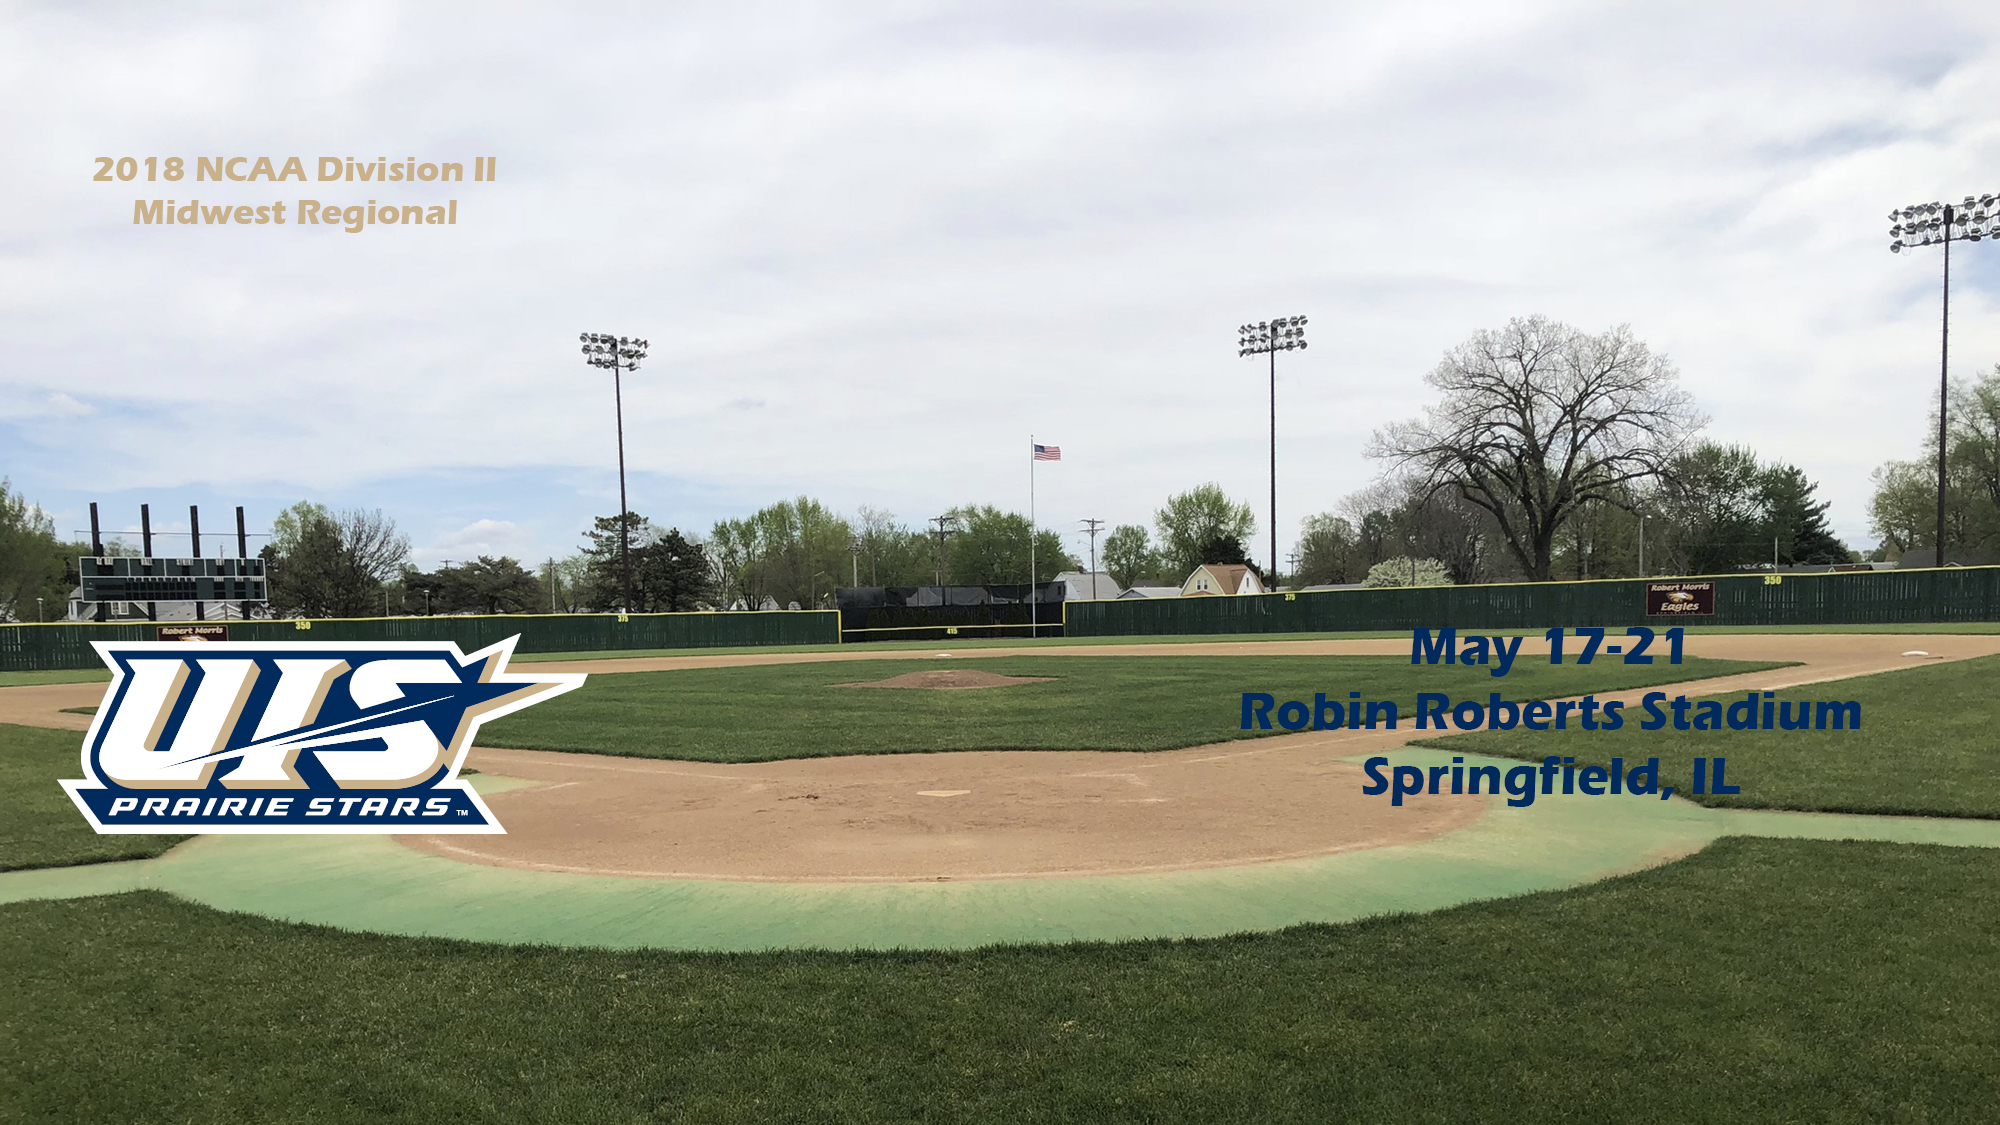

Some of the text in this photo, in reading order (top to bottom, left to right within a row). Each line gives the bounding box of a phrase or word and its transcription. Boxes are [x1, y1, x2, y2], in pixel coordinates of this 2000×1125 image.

[1764, 576, 1782, 585] 350
[1651, 583, 1710, 592] Robert Morris
[1660, 602, 1700, 612] Eagles
[195, 626, 224, 634] Morris
[295, 621, 311, 630] 350
